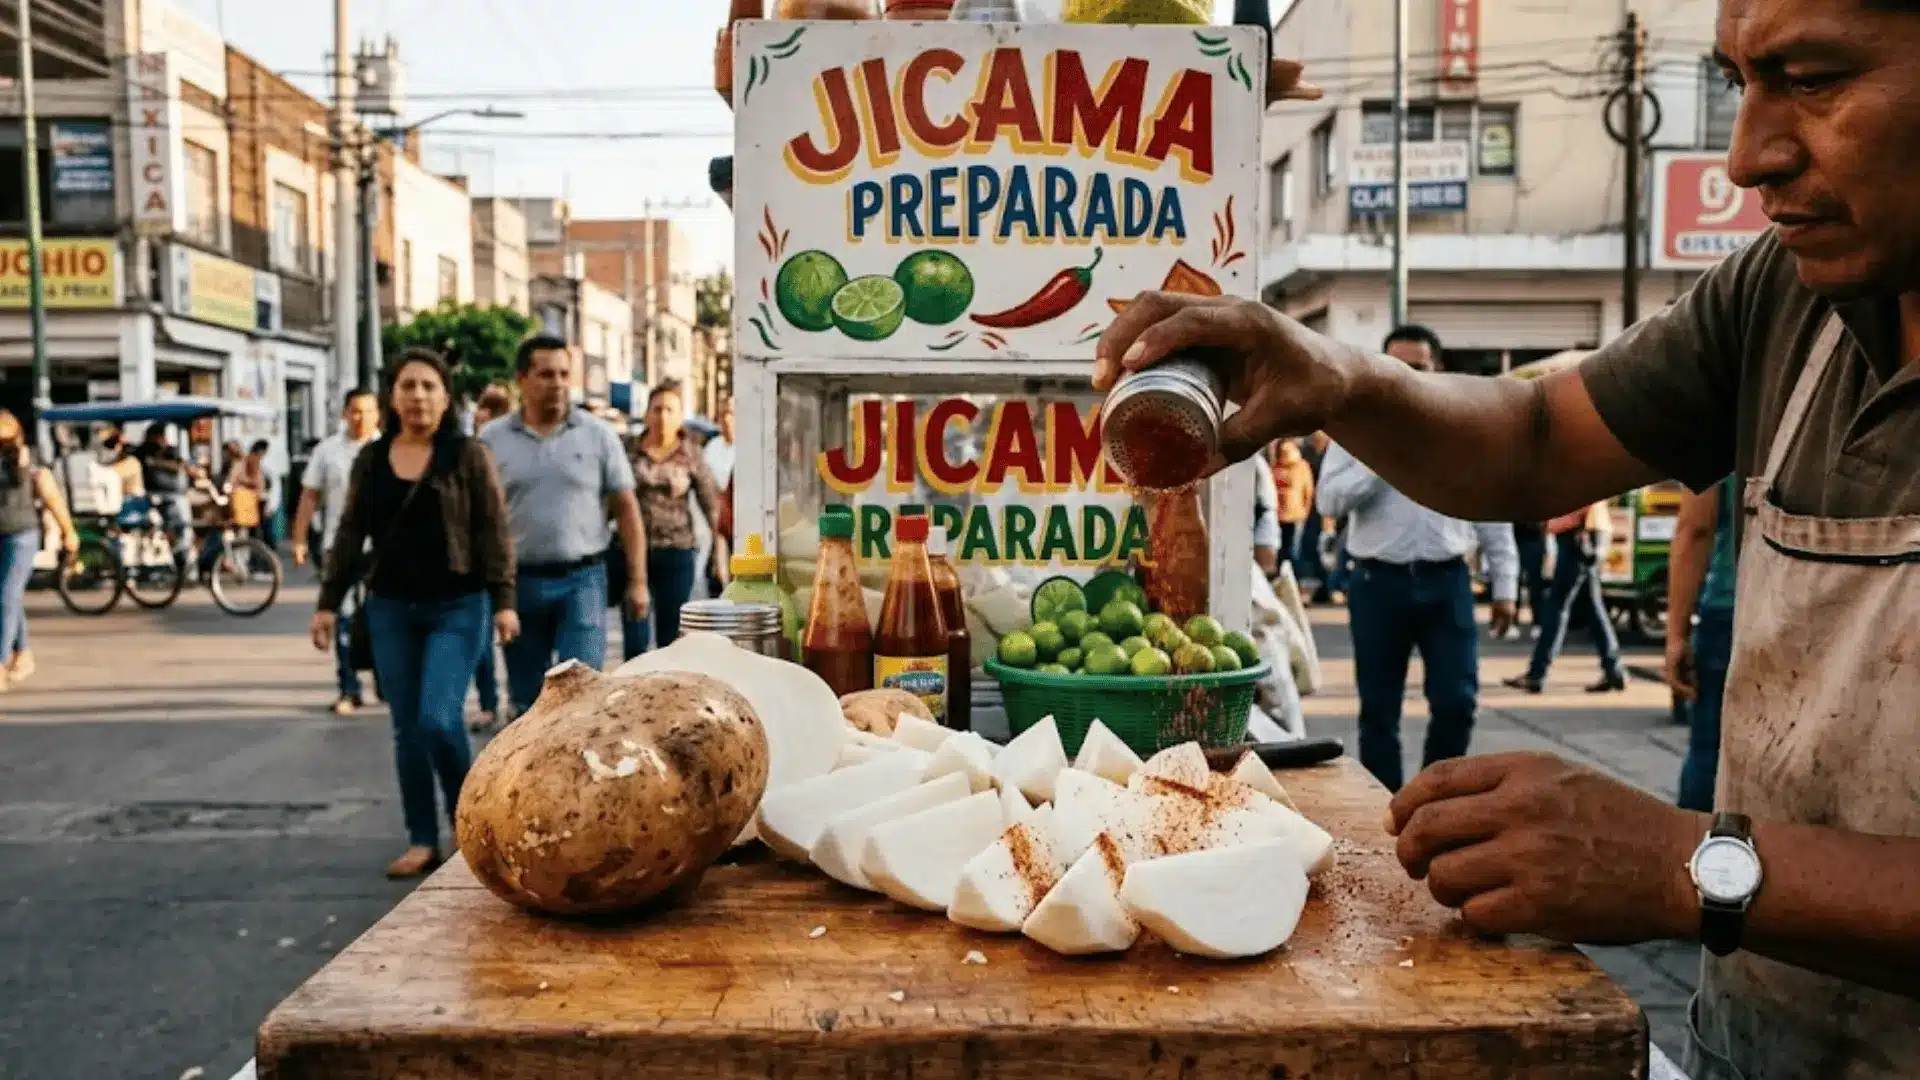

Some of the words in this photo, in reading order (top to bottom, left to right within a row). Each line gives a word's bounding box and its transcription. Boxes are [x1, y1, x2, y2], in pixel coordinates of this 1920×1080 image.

[1448, 0, 1472, 77] INA
[783, 47, 1214, 184] JICAMA
[846, 164, 1186, 245] PREPARADA
[816, 397, 1137, 495] JICAM
